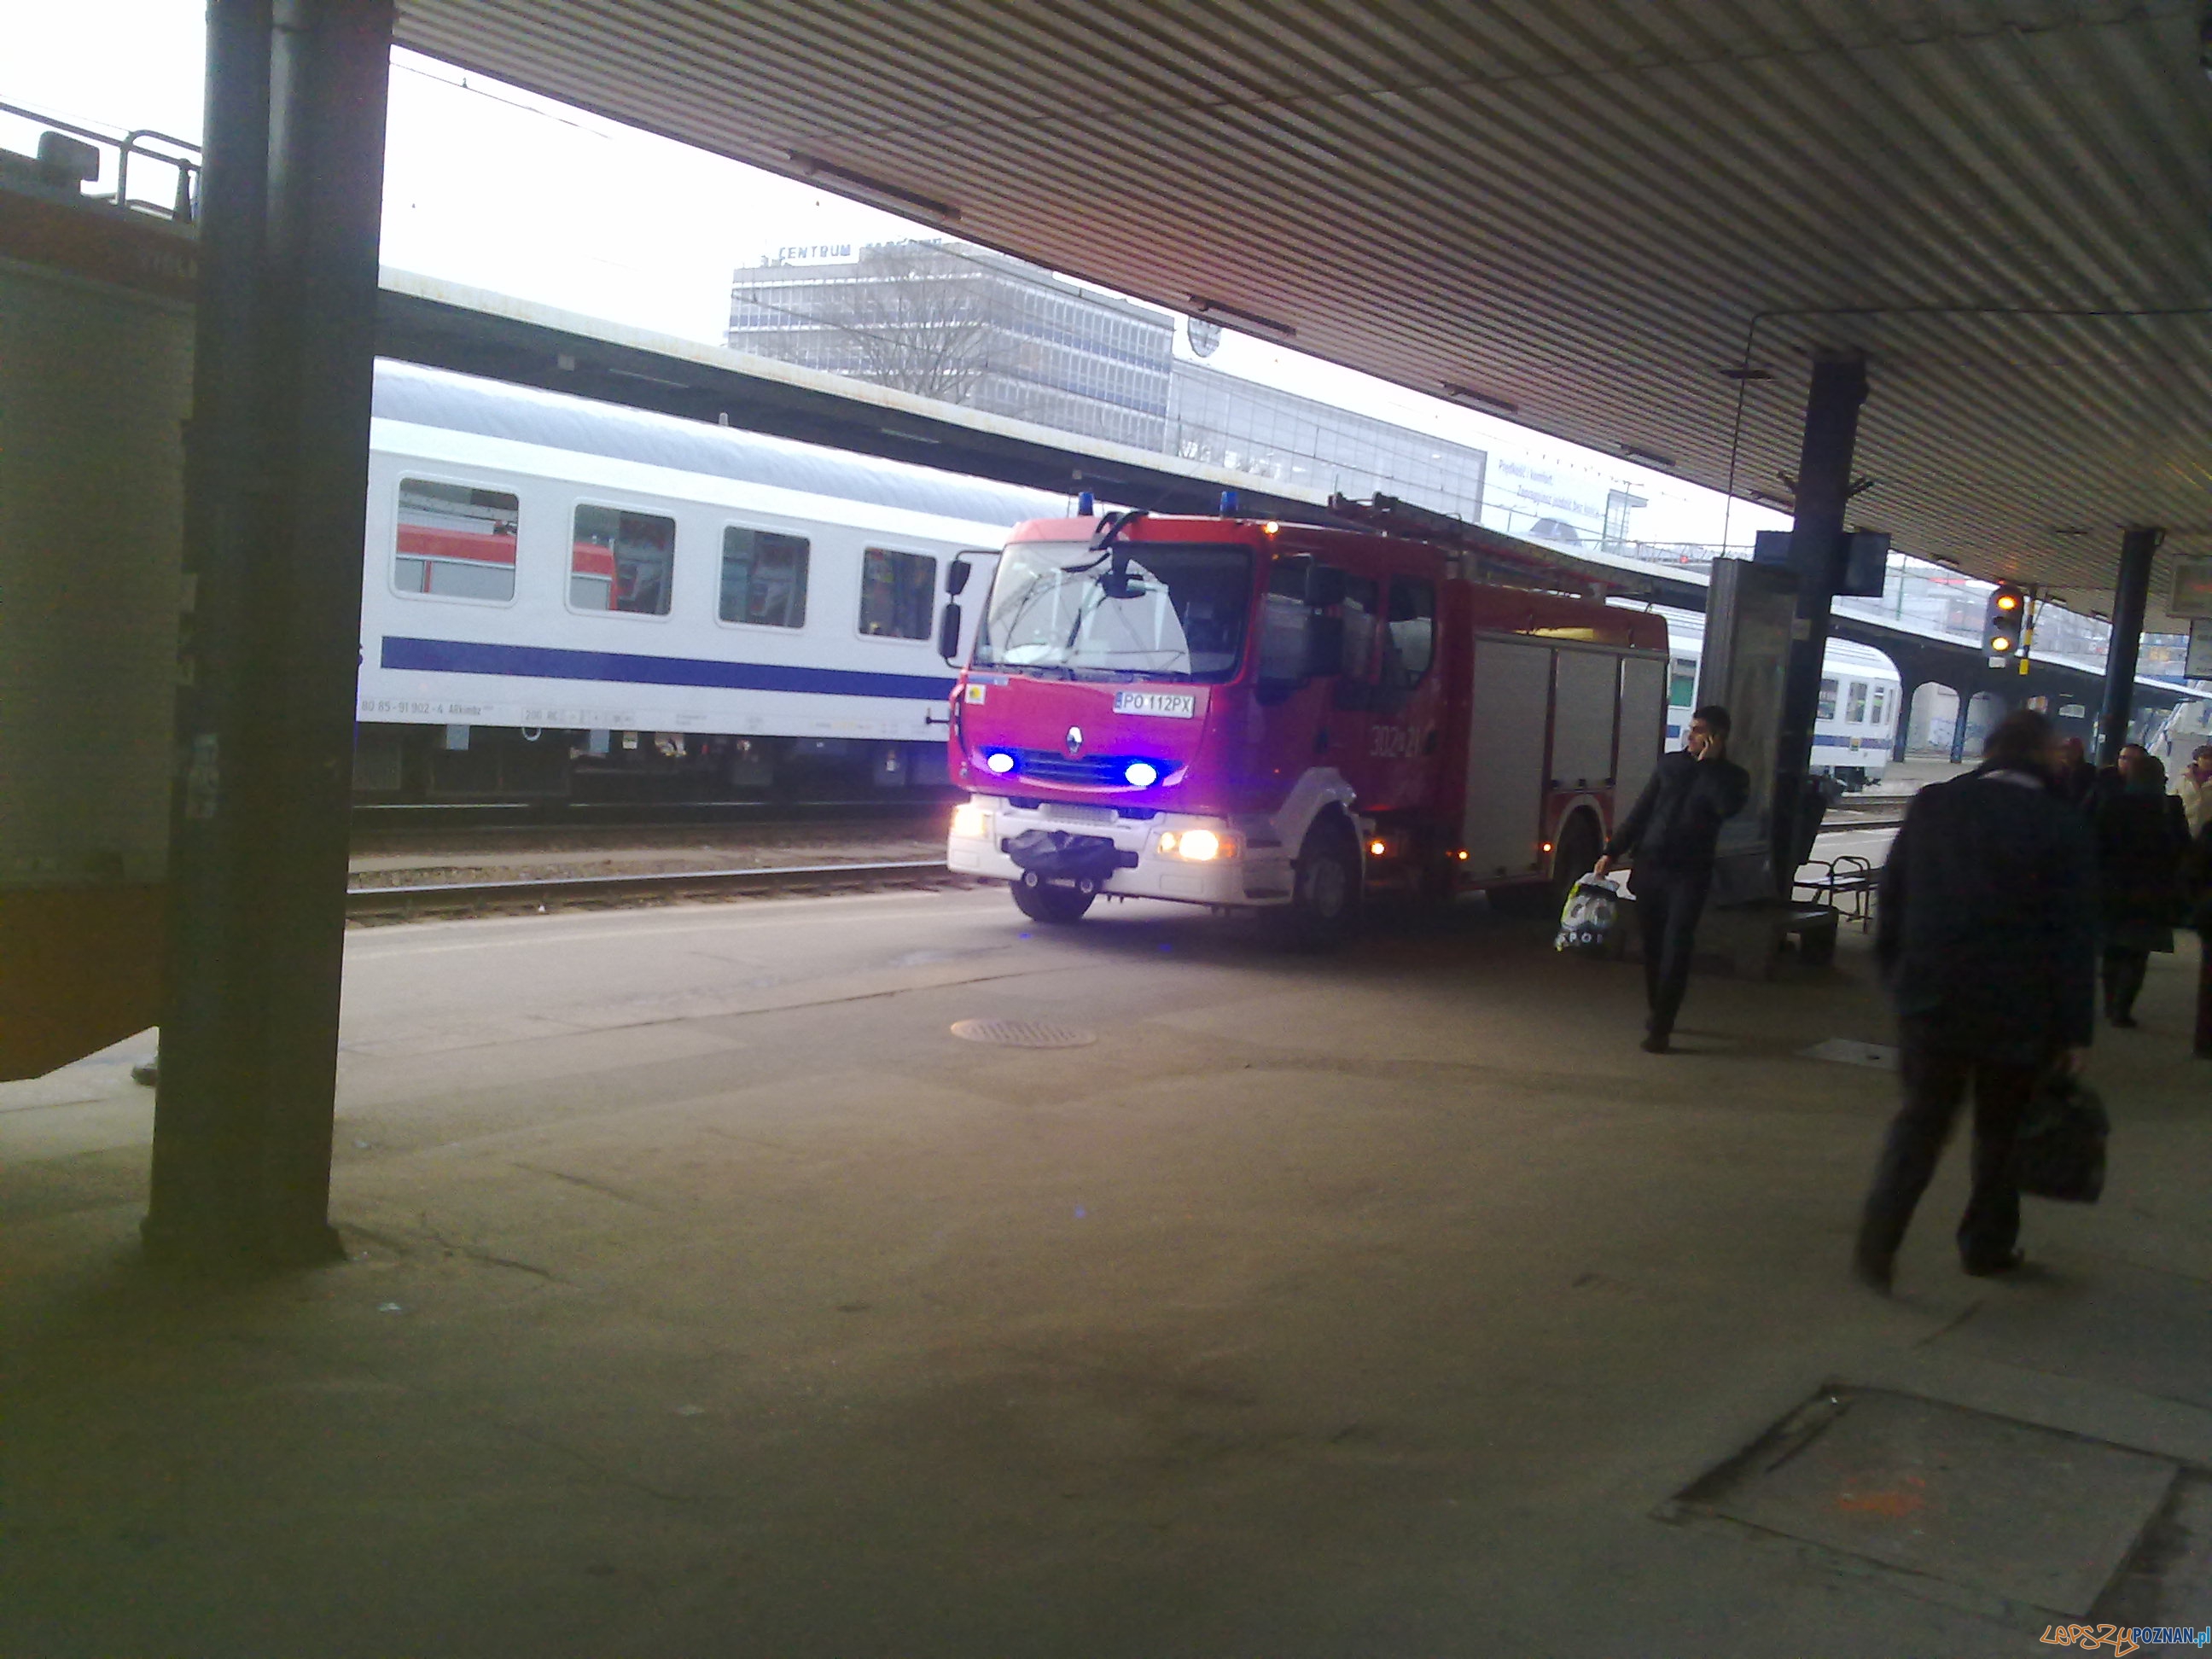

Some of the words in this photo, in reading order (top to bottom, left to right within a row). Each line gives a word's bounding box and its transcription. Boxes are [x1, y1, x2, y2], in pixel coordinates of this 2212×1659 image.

[778, 244, 851, 259] CENTRUM
[1124, 695, 1144, 708] PO
[1150, 696, 1190, 713] 112PX
